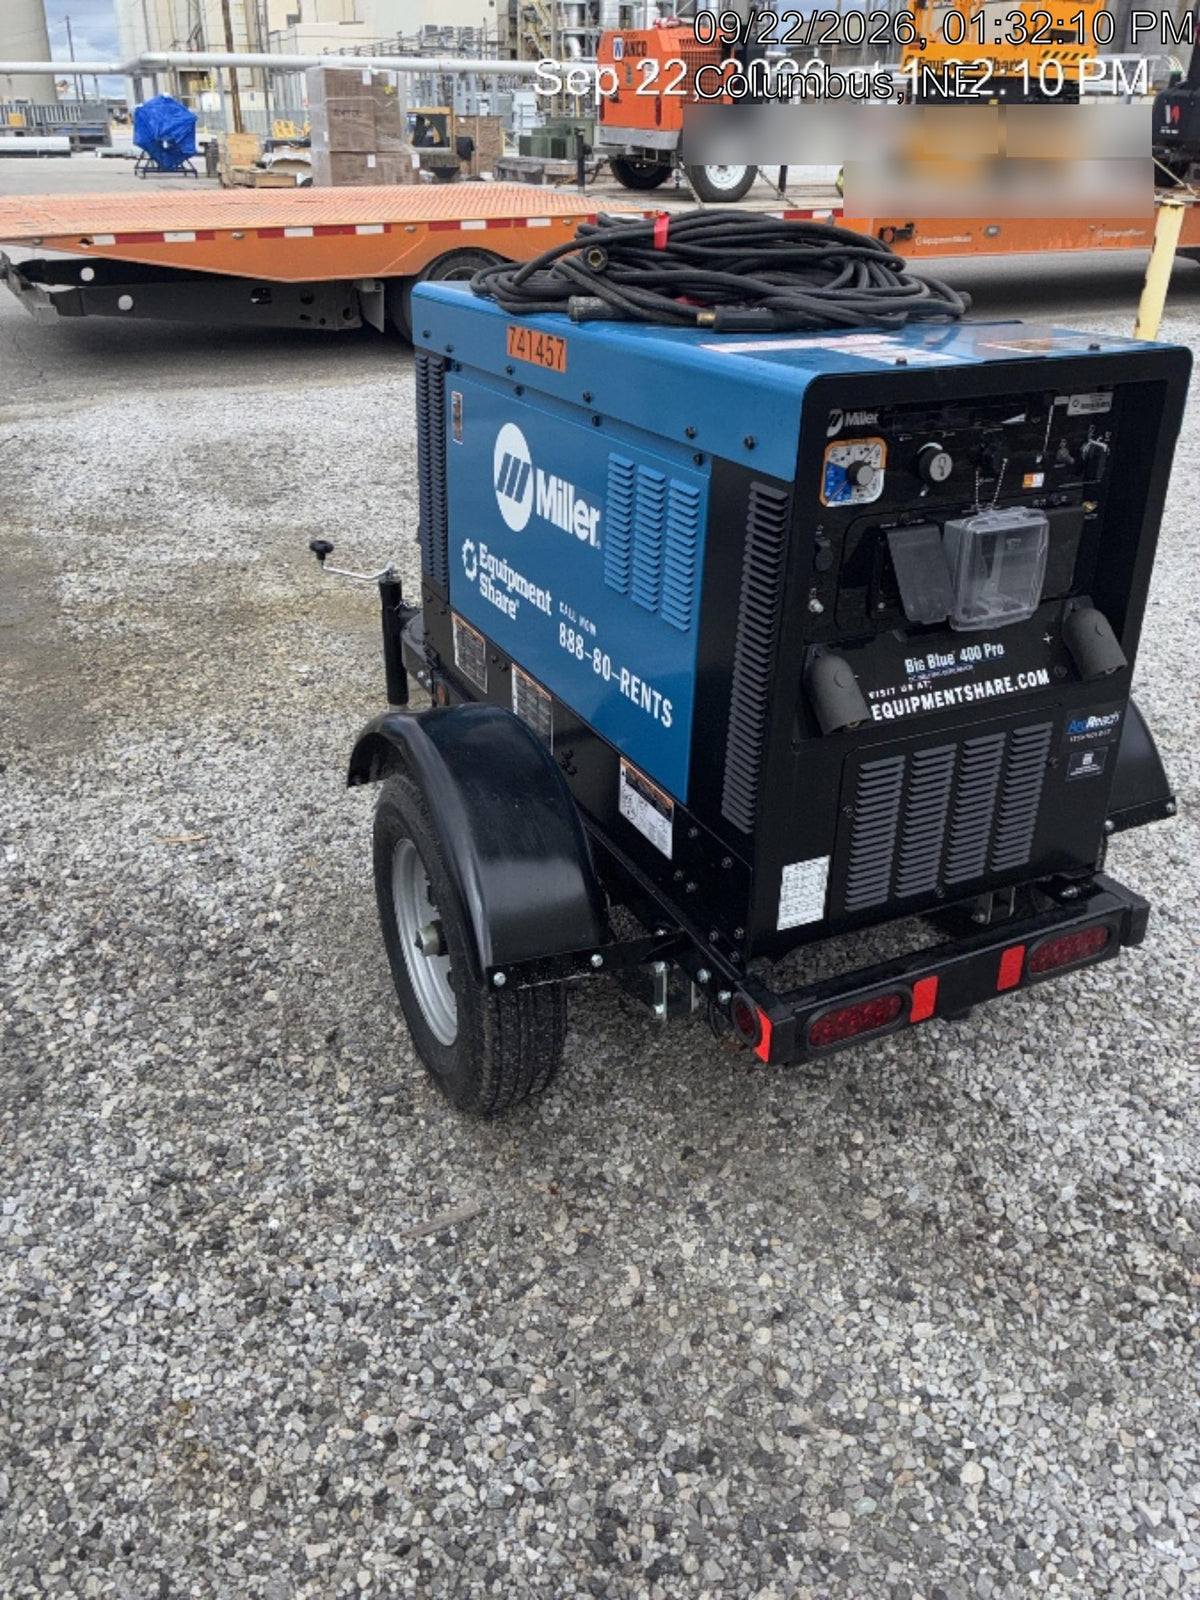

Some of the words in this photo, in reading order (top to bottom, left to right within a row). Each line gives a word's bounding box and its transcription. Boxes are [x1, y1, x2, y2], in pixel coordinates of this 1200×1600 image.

[508, 326, 565, 371] 741457
[845, 411, 879, 426] Miller
[536, 468, 601, 548] Miller
[479, 542, 553, 617] Equipment
[479, 574, 518, 620] Share
[559, 621, 673, 728] 888-80-RENTS
[905, 658, 926, 674] Big
[926, 651, 955, 670] Blue
[960, 644, 982, 662] 400
[983, 642, 1005, 658] Pro
[868, 686, 896, 699] VISIT
[870, 667, 1051, 721] EQUIPMENTSHARE.COM
